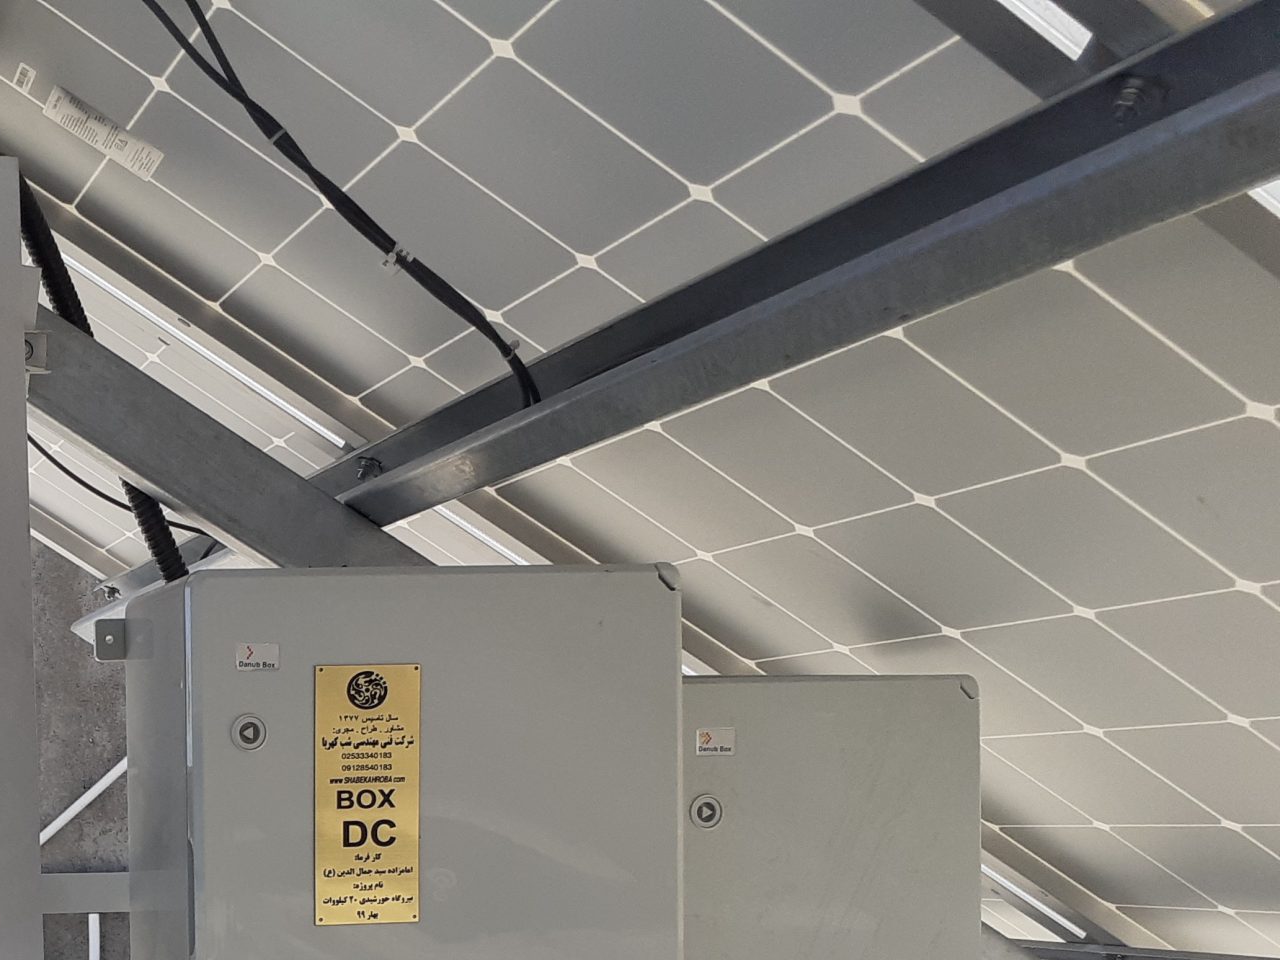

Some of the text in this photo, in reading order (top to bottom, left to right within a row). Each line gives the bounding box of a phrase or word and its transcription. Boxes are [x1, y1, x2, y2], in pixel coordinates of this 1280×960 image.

[238, 660, 261, 668] Danub
[338, 714, 359, 722] ۱۳۷۷
[385, 713, 399, 723] سال
[360, 724, 378, 735] طراح
[384, 724, 404, 734] مشاور
[352, 737, 379, 749] مهندسی
[380, 734, 393, 749] فنی
[394, 734, 414, 748] شرکت
[341, 751, 392, 760] 02533340183
[341, 763, 393, 772] 09128540183
[336, 788, 396, 809] BOX
[342, 819, 396, 847] DC
[336, 867, 355, 877] الدین
[356, 867, 373, 877] جمال
[374, 868, 387, 877] سید
[387, 866, 413, 876] امامزاده
[374, 881, 384, 890] نام
[356, 910, 366, 919] ۹۹
